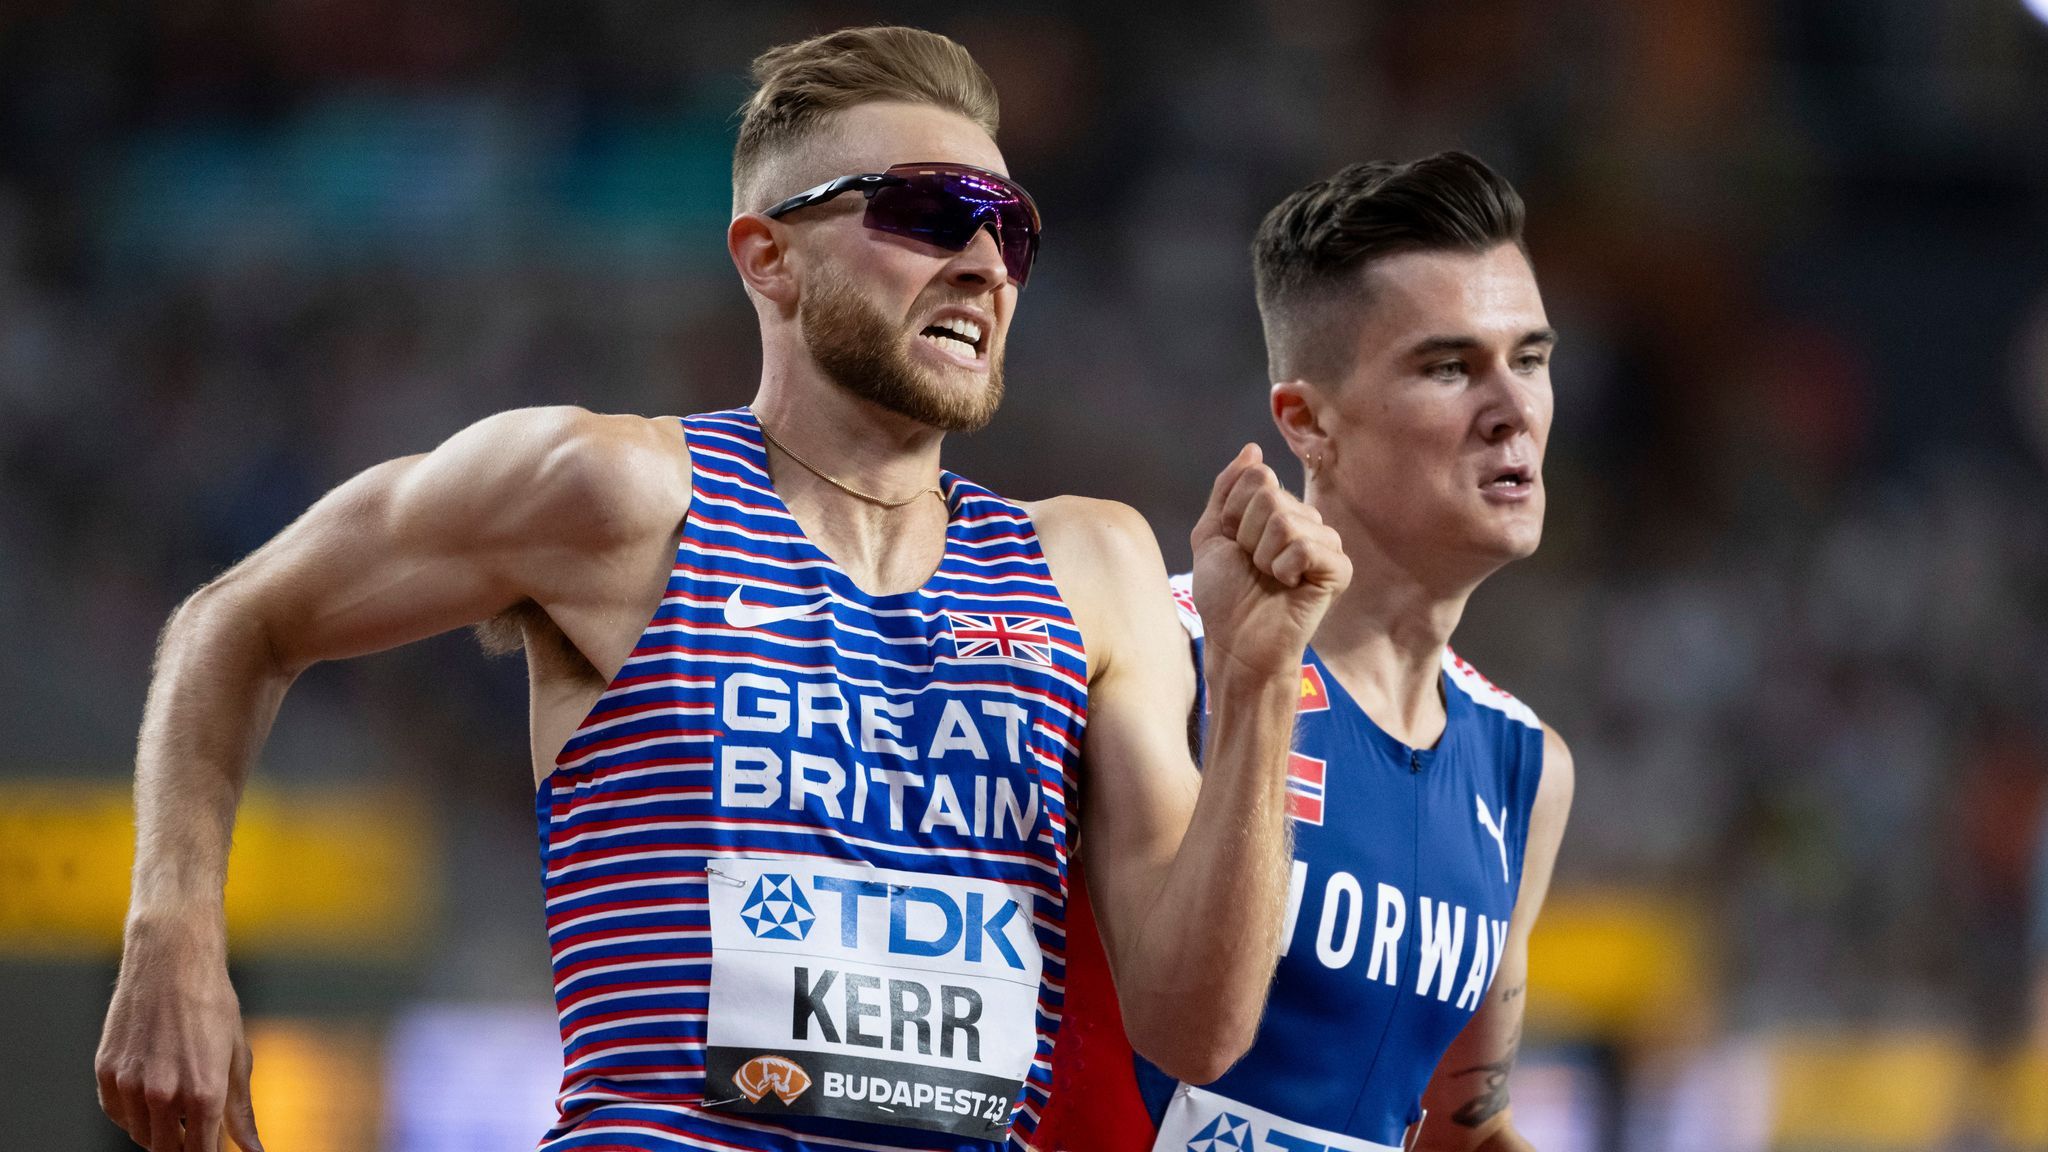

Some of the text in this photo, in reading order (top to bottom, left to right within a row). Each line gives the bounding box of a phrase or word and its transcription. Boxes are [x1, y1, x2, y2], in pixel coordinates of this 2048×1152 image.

[722, 672, 1028, 765] GREAT
[720, 744, 1039, 842] BRITAIN
[812, 874, 1026, 971] TDK
[791, 965, 984, 1063] KERR
[822, 1071, 1008, 1122] BUDAPEST23
